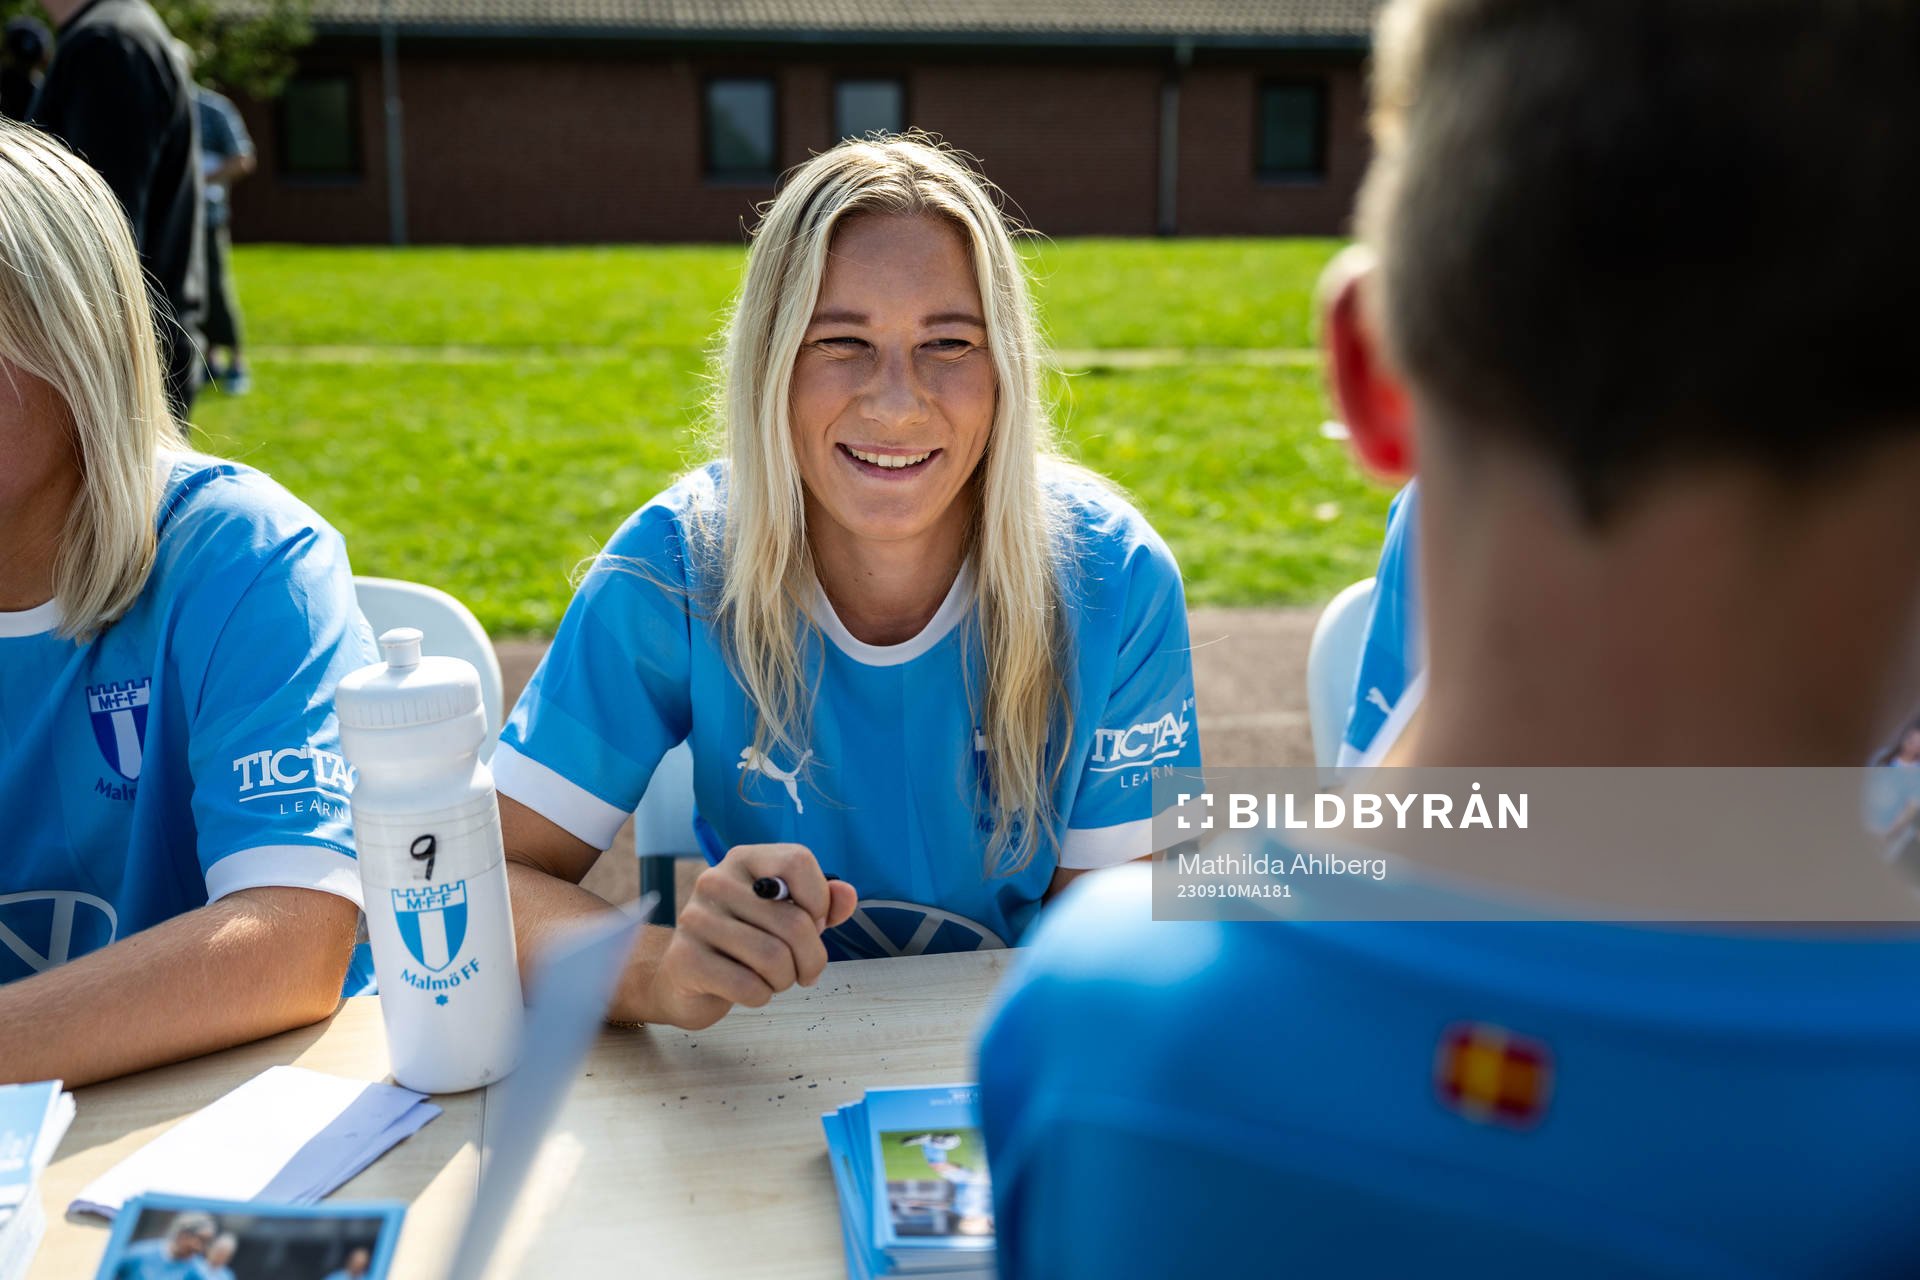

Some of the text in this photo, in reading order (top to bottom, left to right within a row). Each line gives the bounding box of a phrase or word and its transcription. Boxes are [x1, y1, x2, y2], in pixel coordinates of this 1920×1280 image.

[1120, 763, 1175, 789] LEARN
[279, 799, 345, 820] LEARN
[409, 833, 437, 881] 9
[400, 957, 480, 991] Malmö FF
